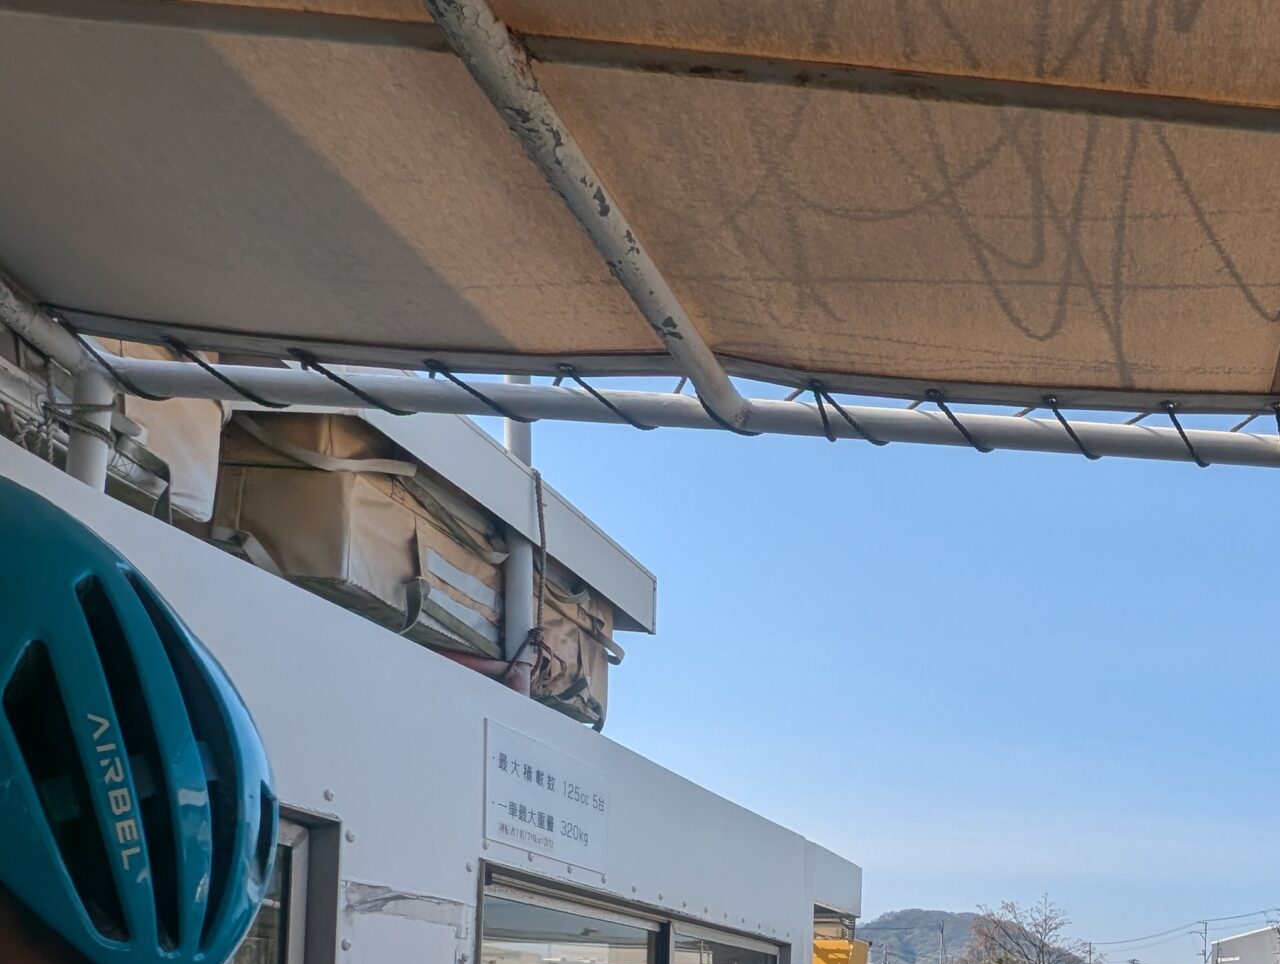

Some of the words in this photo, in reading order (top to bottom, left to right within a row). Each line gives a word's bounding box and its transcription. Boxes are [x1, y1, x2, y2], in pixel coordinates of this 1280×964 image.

[87, 713, 149, 883] AIRBEL
[563, 780, 590, 806] 125cc
[592, 793, 605, 812] 5台
[498, 800, 555, 832] 一車最大重量
[560, 820, 589, 847] 320kg
